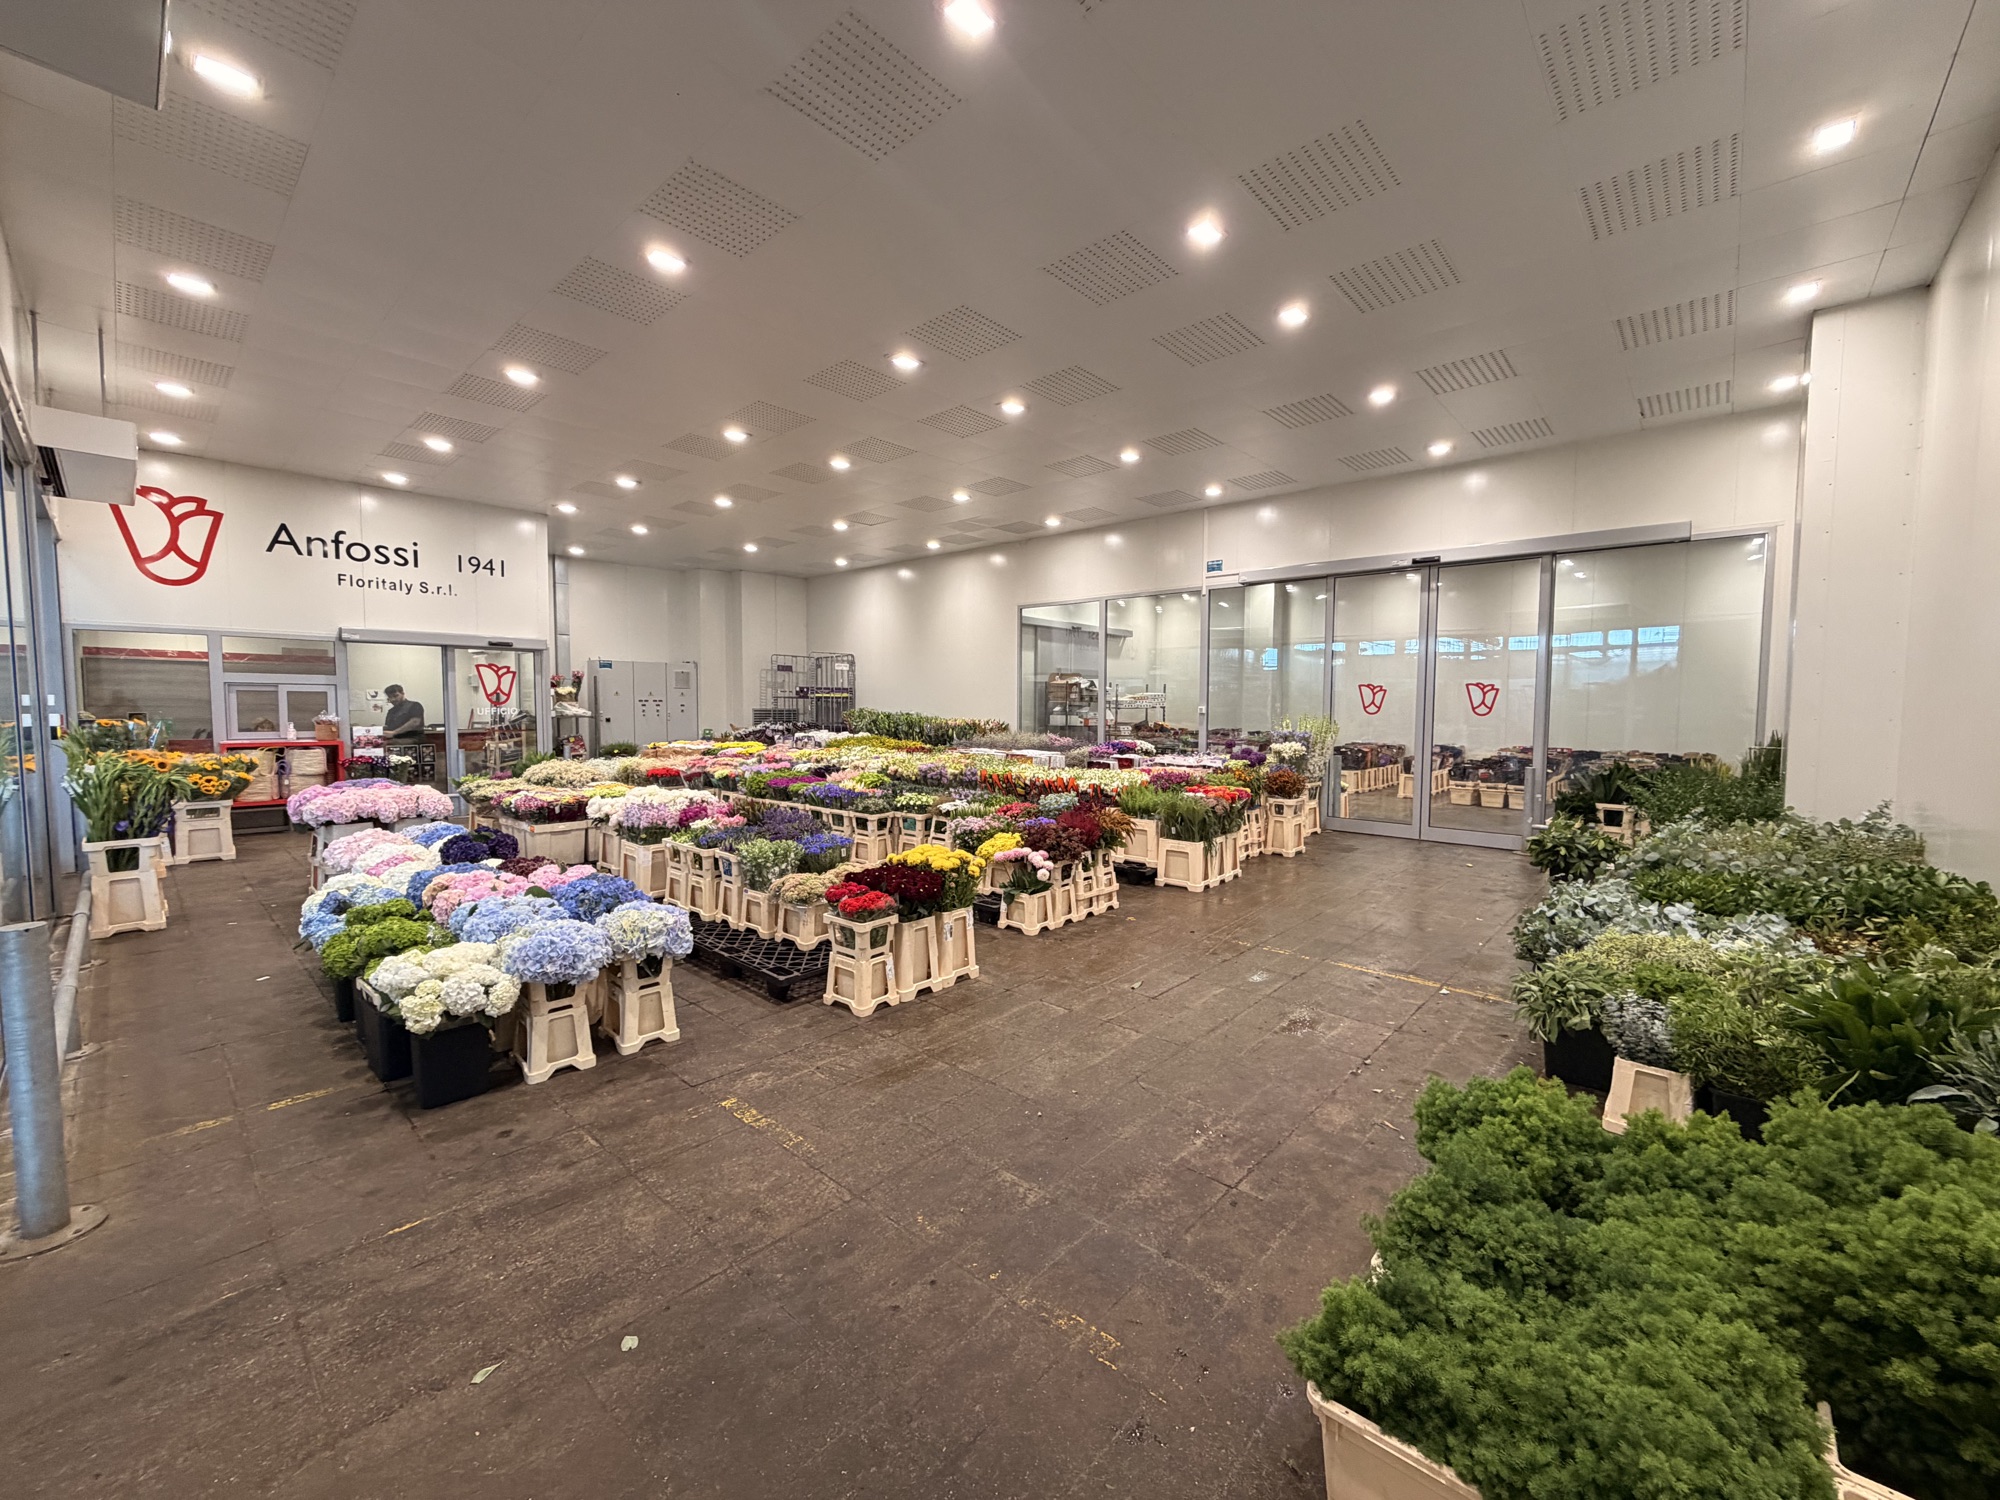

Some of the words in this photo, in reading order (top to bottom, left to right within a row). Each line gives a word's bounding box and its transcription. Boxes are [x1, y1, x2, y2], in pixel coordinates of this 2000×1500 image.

[265, 522, 420, 568] Anfossi
[457, 554, 506, 578] 1941
[337, 573, 413, 595] Floritaly
[419, 581, 458, 596] S.r.l.
[476, 706, 519, 716] UFFICIO
